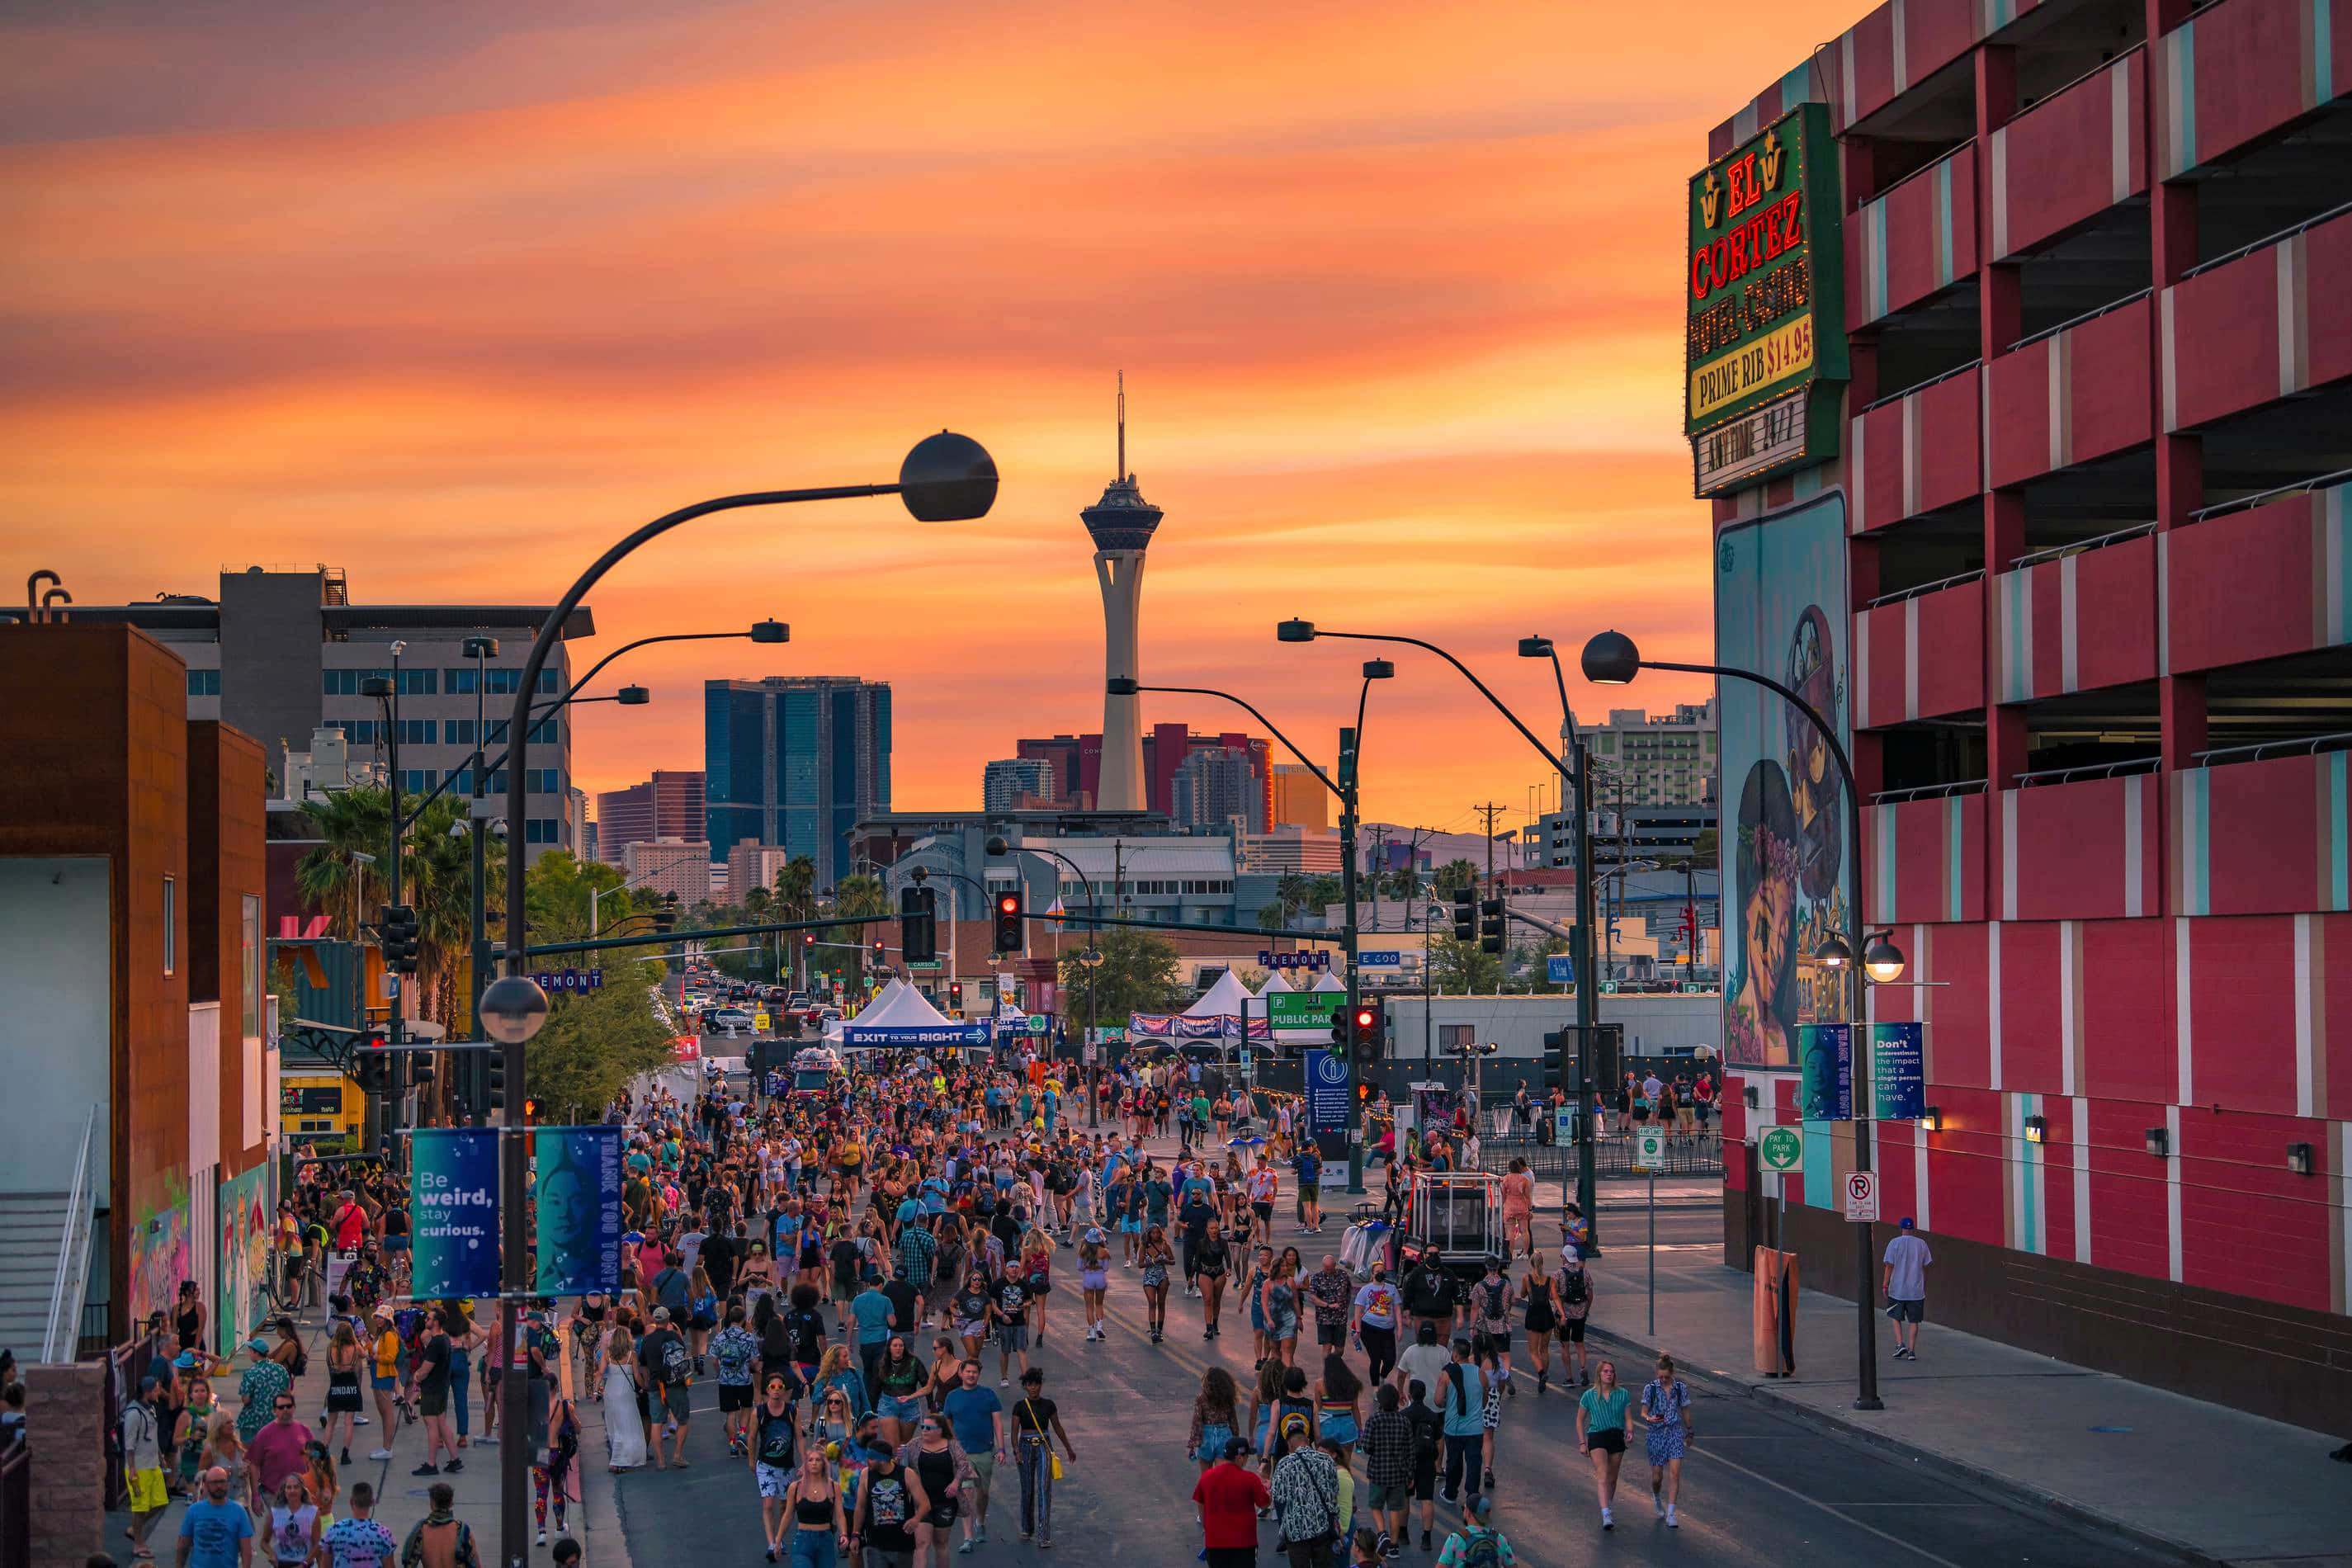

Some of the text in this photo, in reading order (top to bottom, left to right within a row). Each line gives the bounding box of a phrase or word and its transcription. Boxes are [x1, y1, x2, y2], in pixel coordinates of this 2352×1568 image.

[1727, 152, 1762, 219] EL
[1693, 189, 1802, 299] CORTEZ
[1699, 322, 1810, 408] PRIME RIB $14.95
[1262, 955, 1327, 965] FREMONT
[1273, 1014, 1332, 1024] PUBLIC PAR
[853, 1033, 888, 1042] EXIT
[919, 1032, 962, 1041] RIGHT
[1877, 1040, 1908, 1048] Don't
[1892, 1057, 1920, 1066] impact
[1878, 1093, 1906, 1102] have.
[1769, 1135, 1794, 1143] PAY TO
[1772, 1144, 1790, 1153] PARK
[420, 1172, 449, 1188] Be
[419, 1188, 494, 1208] weird,
[419, 1208, 451, 1222] stay
[601, 1135, 618, 1285] THANK YOU TONY
[419, 1223, 485, 1237] curious.
